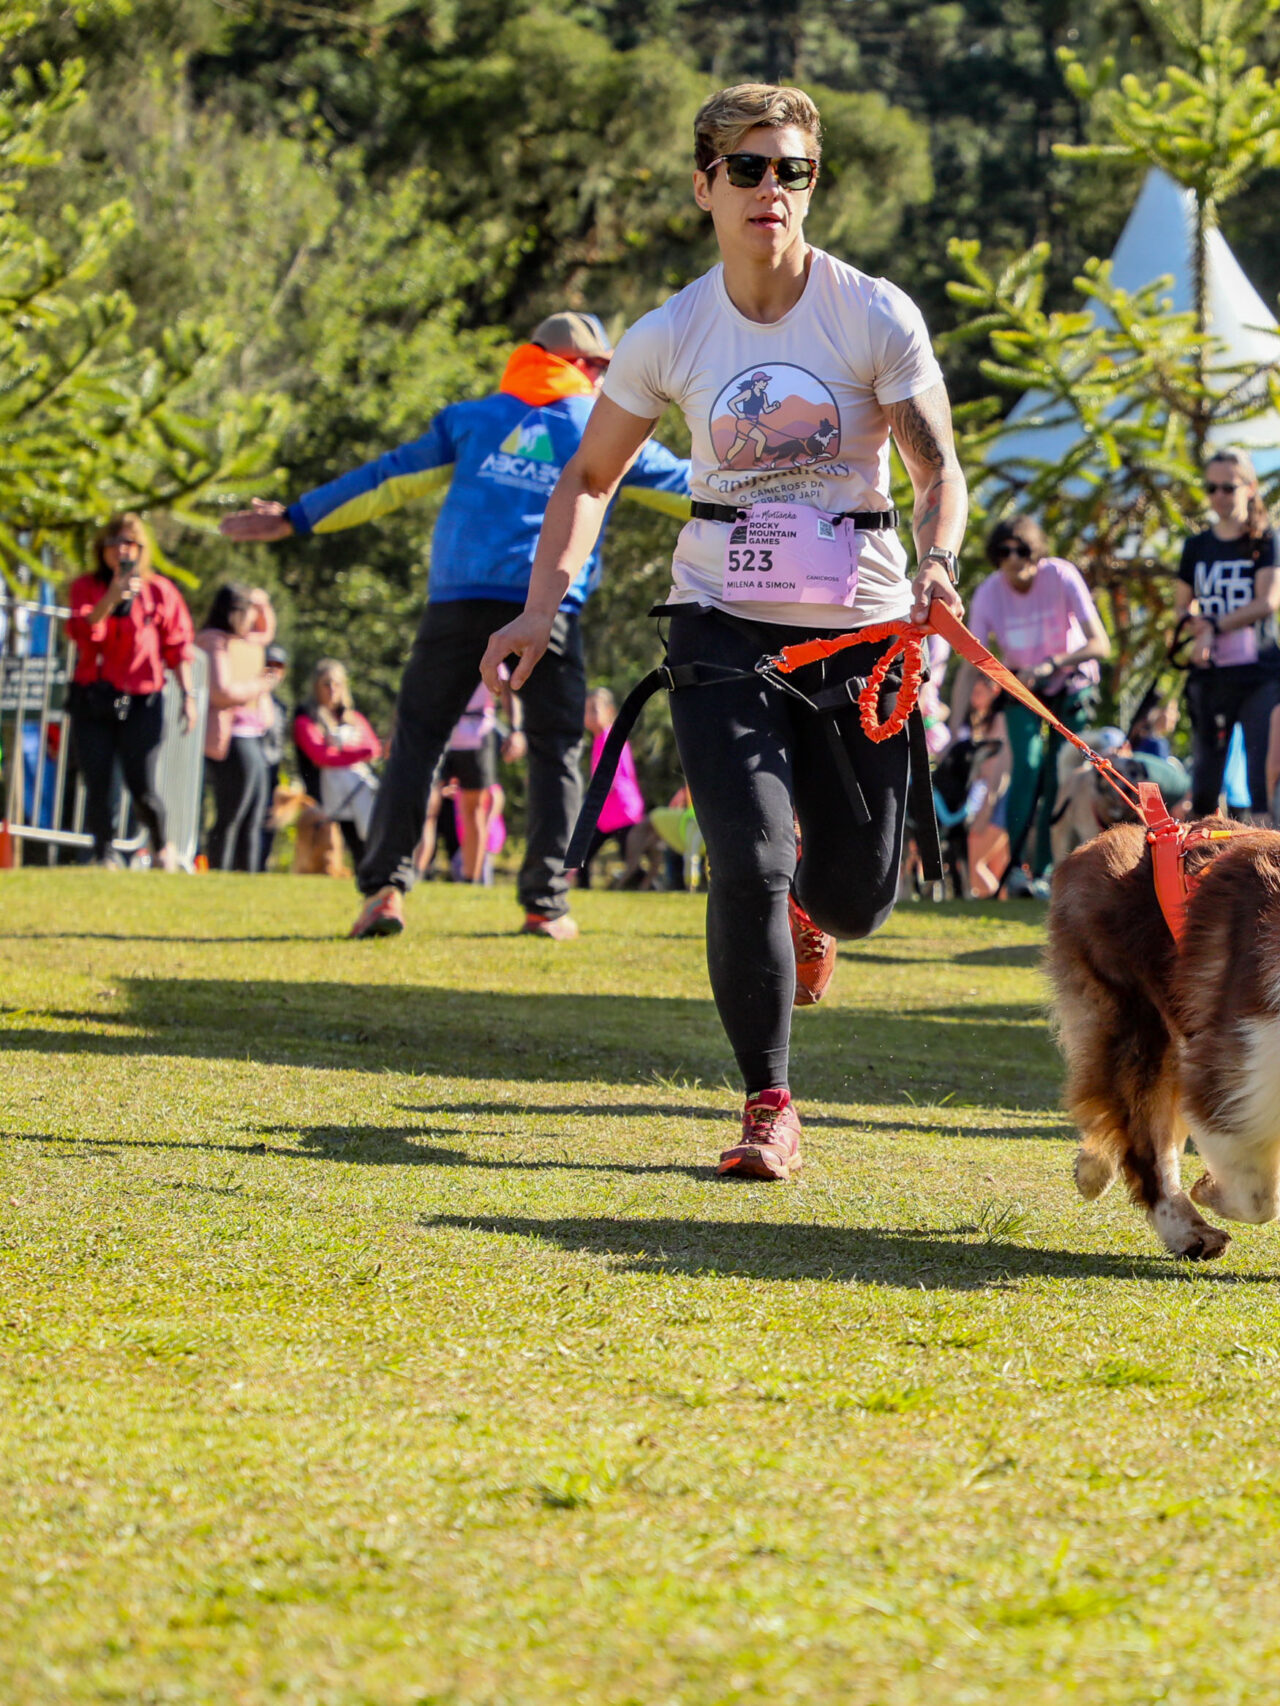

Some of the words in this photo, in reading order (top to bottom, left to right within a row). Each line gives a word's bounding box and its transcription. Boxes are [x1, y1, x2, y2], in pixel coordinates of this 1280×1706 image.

[750, 481, 807, 498] CANICROSS
[810, 480, 824, 489] DA
[782, 493, 795, 503] DO
[799, 490, 820, 499] JAPI
[750, 522, 780, 530] ROCKY
[749, 530, 797, 539] MOUNTAIN
[748, 538, 780, 546] GAMES
[728, 549, 773, 572] 523
[727, 580, 754, 589] MILENA
[757, 580, 763, 588] &
[765, 581, 796, 589] SIMON
